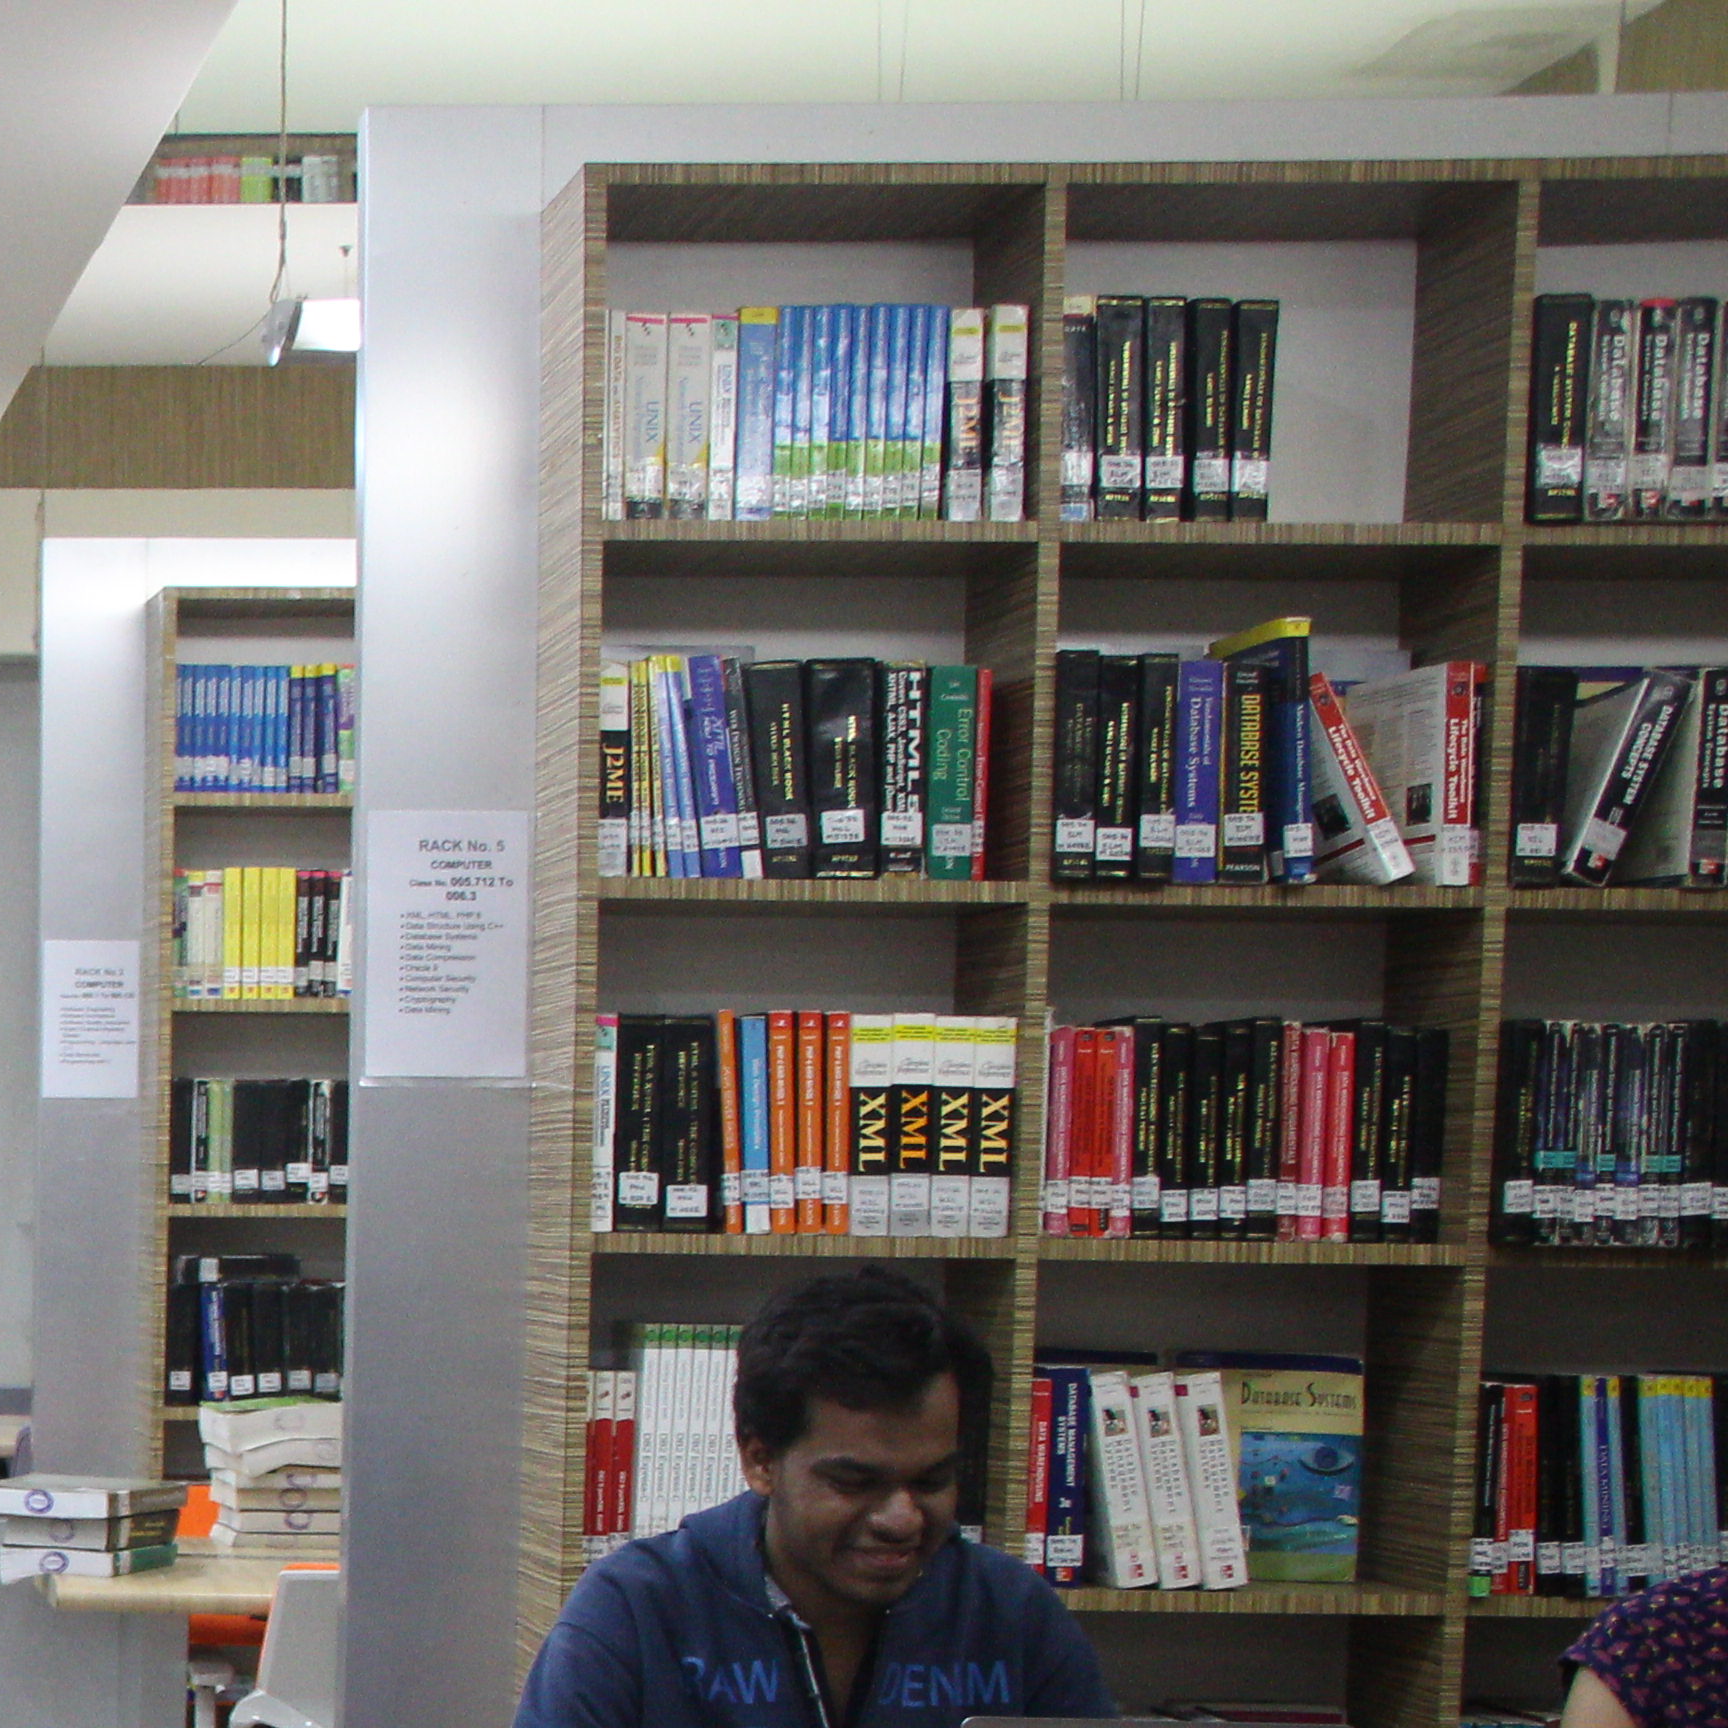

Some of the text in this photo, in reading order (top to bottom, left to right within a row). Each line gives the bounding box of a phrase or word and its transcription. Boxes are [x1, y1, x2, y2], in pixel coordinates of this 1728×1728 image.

[1609, 336, 1626, 421] Database
[1651, 334, 1668, 420] Database
[1693, 333, 1710, 420] Database
[604, 745, 625, 805] J2ME
[933, 729, 951, 780] Coding
[956, 708, 973, 801] Error Control
[1188, 698, 1201, 809] Database Systems
[1238, 693, 1262, 814] DATABASE SYSTE
[1447, 718, 1460, 767] Lifecycle
[419, 839, 505, 852] RACK No. 5
[430, 860, 493, 869] COMPUTER
[858, 1091, 888, 1173] XML
[899, 1088, 929, 1169] XML
[939, 1090, 970, 1172] XML
[979, 1092, 1009, 1173] XML
